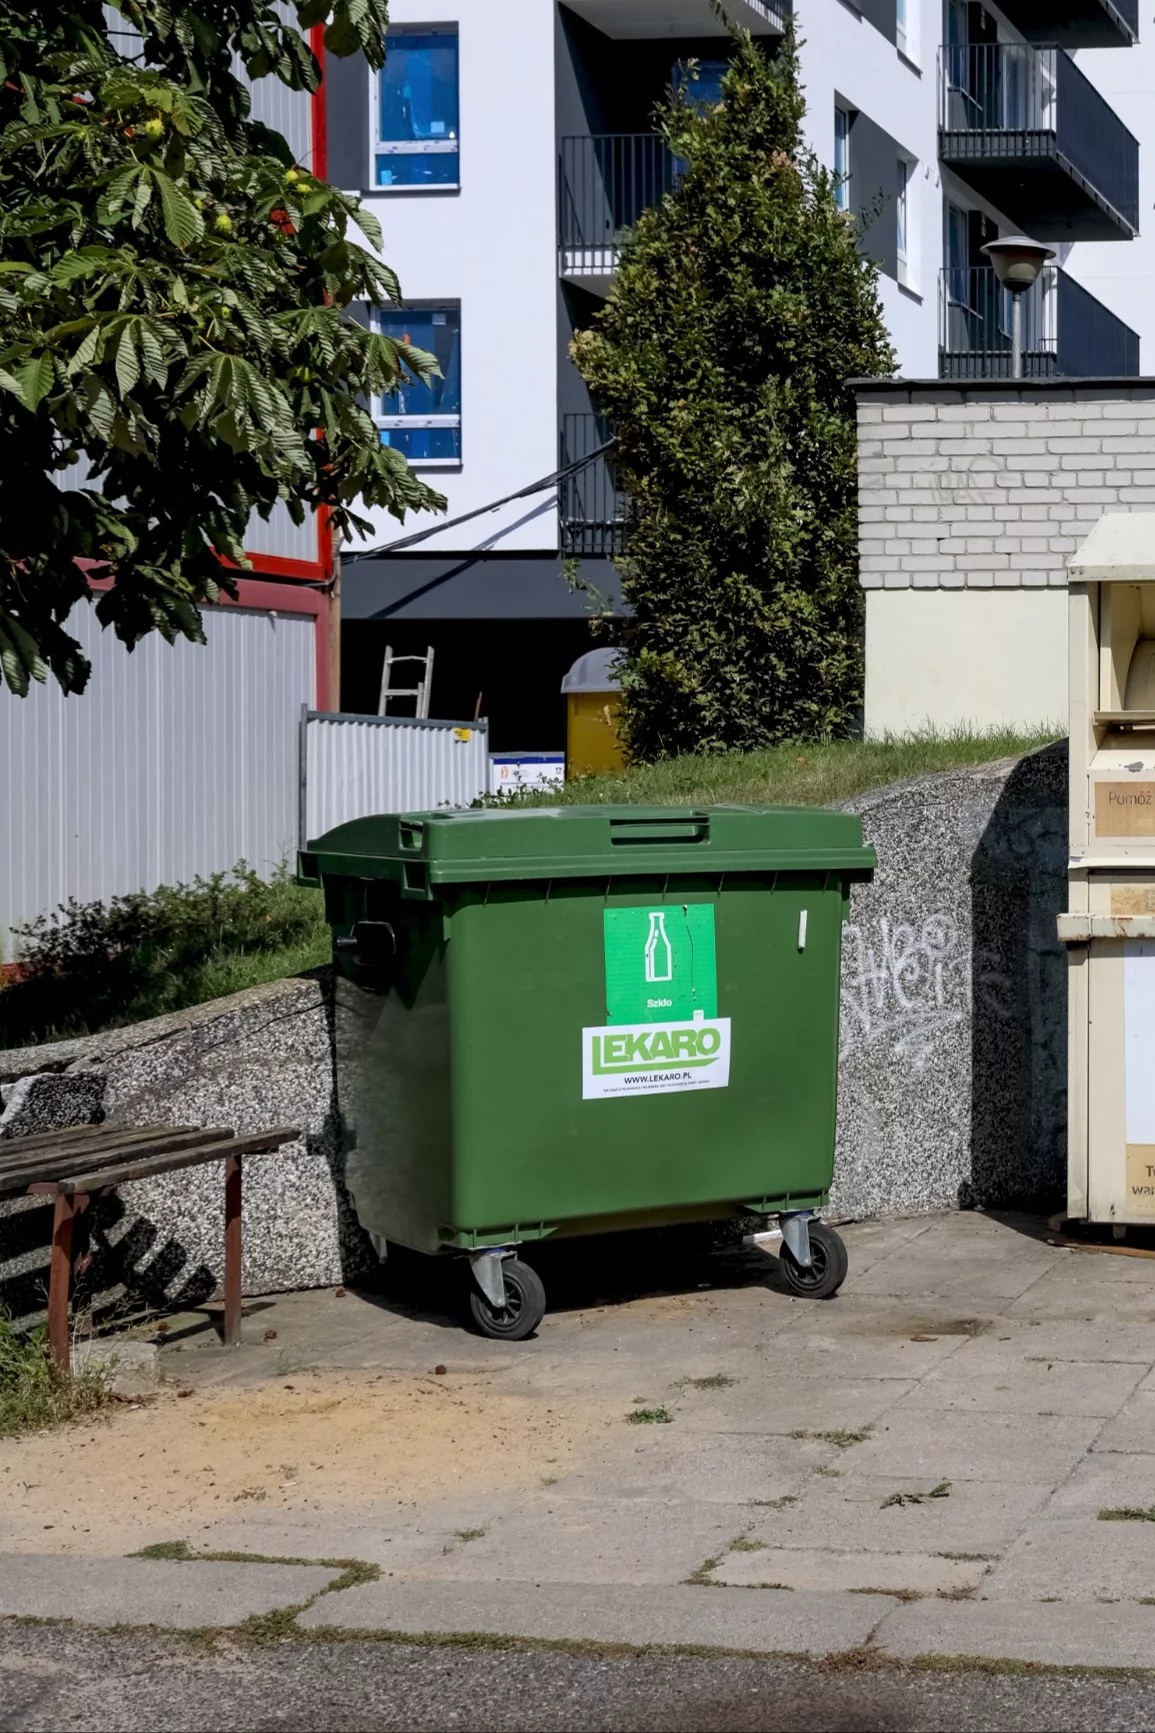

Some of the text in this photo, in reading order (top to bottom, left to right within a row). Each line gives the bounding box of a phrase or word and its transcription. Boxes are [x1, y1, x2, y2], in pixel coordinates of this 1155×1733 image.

[1108, 789, 1152, 806] Pomóż
[592, 1027, 721, 1075] LEKARO
[624, 1072, 692, 1084] WWW.LEKARO.PL
